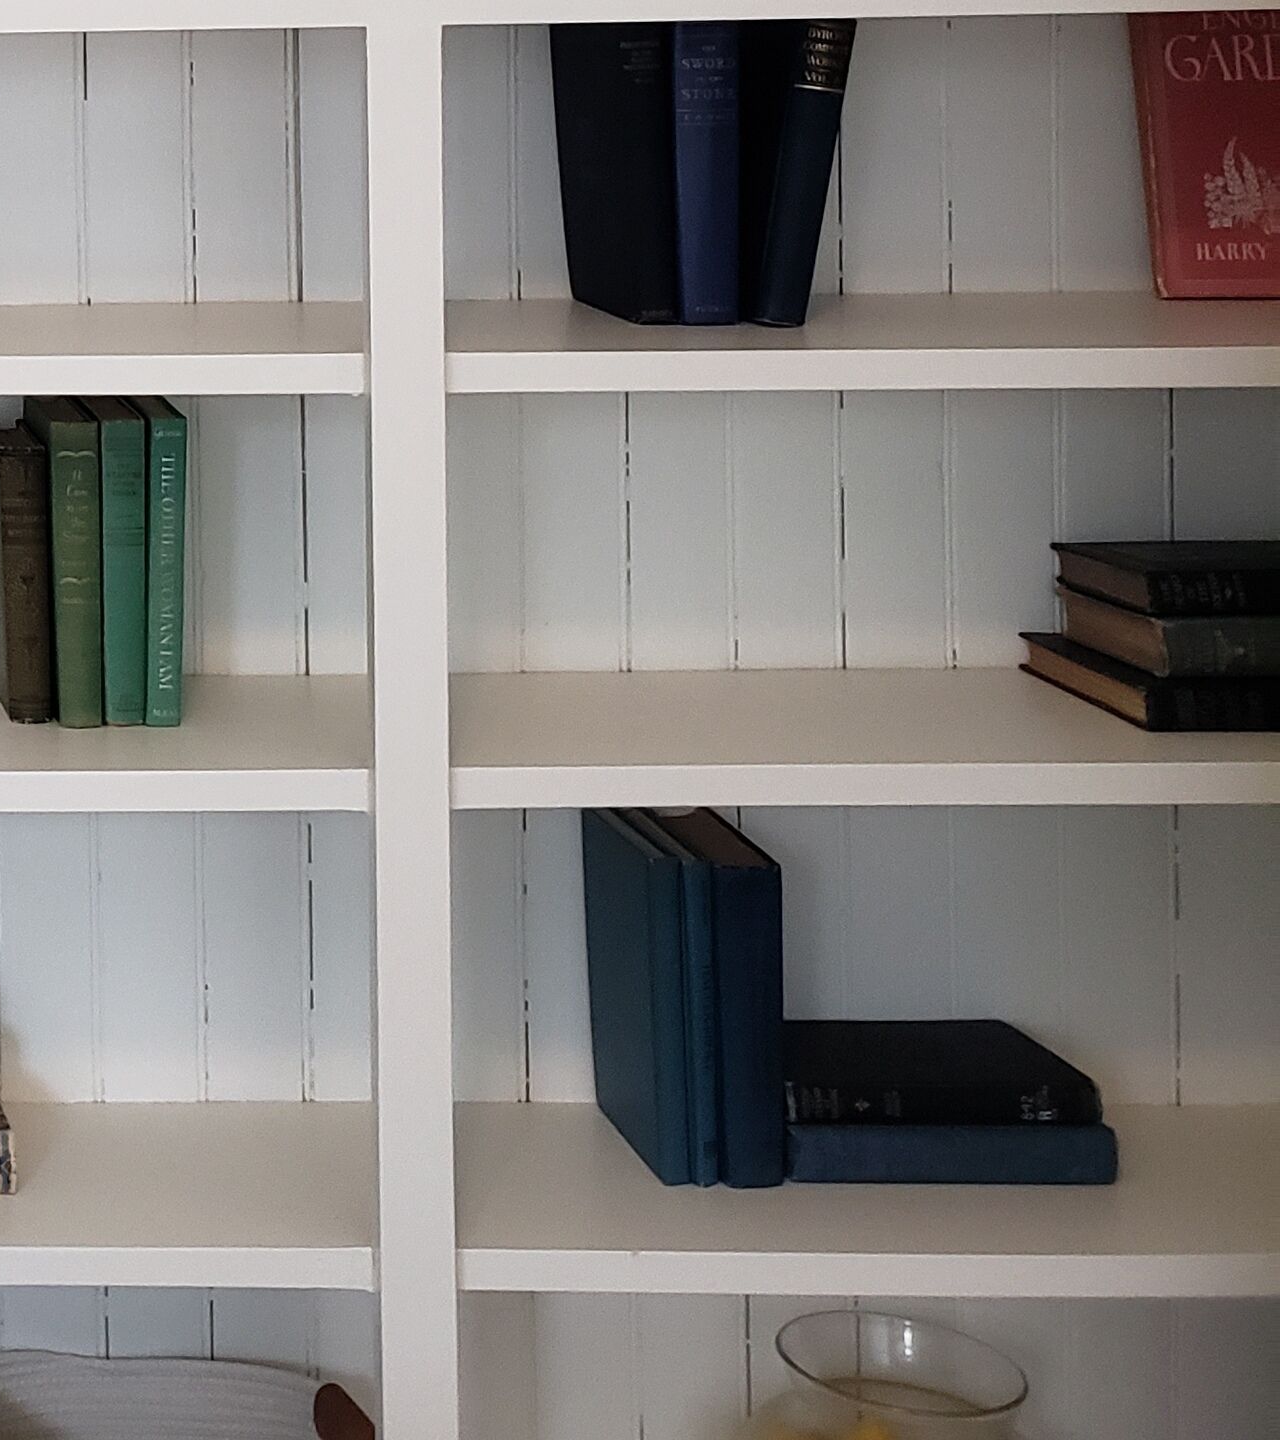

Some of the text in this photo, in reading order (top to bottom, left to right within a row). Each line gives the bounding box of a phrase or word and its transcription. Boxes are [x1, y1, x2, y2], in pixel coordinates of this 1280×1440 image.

[680, 58, 736, 70] SWORD
[1196, 241, 1268, 262] HARRY
[159, 453, 176, 495] THE
[159, 497, 176, 566] OTHER
[158, 569, 177, 645] WOMAN
[157, 658, 173, 691] AM
